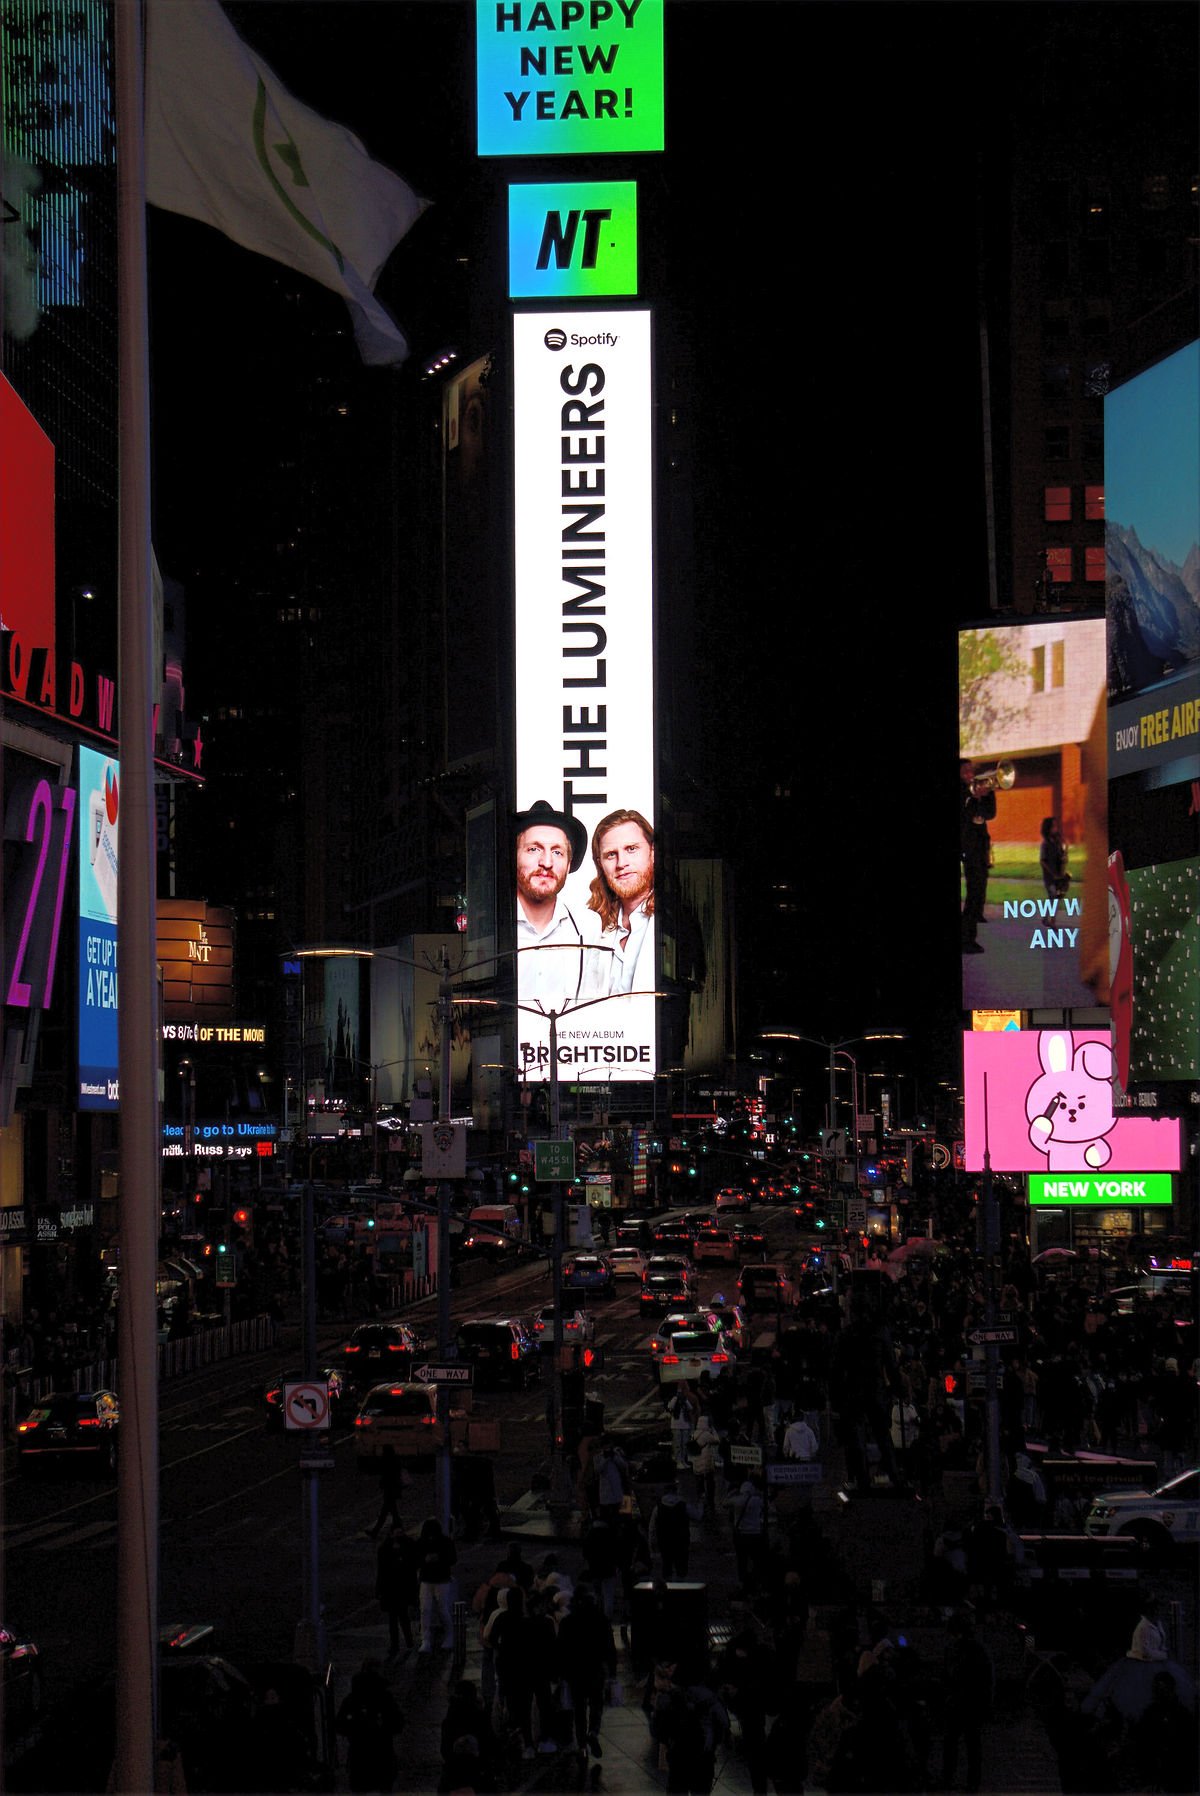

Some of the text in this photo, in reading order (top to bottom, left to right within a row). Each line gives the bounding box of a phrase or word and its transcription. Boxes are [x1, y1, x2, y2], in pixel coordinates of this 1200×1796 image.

[496, 0, 642, 32] HAPPY
[520, 44, 620, 76] NEW
[504, 88, 633, 121] YEAR!
[570, 332, 618, 348] Spotify
[560, 363, 608, 818] THE LUMINEERS
[1116, 725, 1139, 751] ENJOY
[1141, 709, 1169, 749] FREE
[1003, 898, 1059, 919] NOW
[1029, 927, 1080, 949] ANY
[87, 935, 101, 965] GET
[102, 939, 112, 967] UP
[86, 967, 95, 1007] A
[200, 1027, 214, 1041] OF
[215, 1028, 241, 1041] THE
[569, 1030, 591, 1039] NEW
[592, 1030, 625, 1039] ALBUM
[524, 1044, 651, 1064] BRGHTSIDE
[203, 1127, 219, 1138] go
[222, 1124, 234, 1135] to
[194, 1143, 223, 1155] Russ
[1043, 1181, 1147, 1198] NEW YORK
[420, 1368, 465, 1380] ONE WAY
